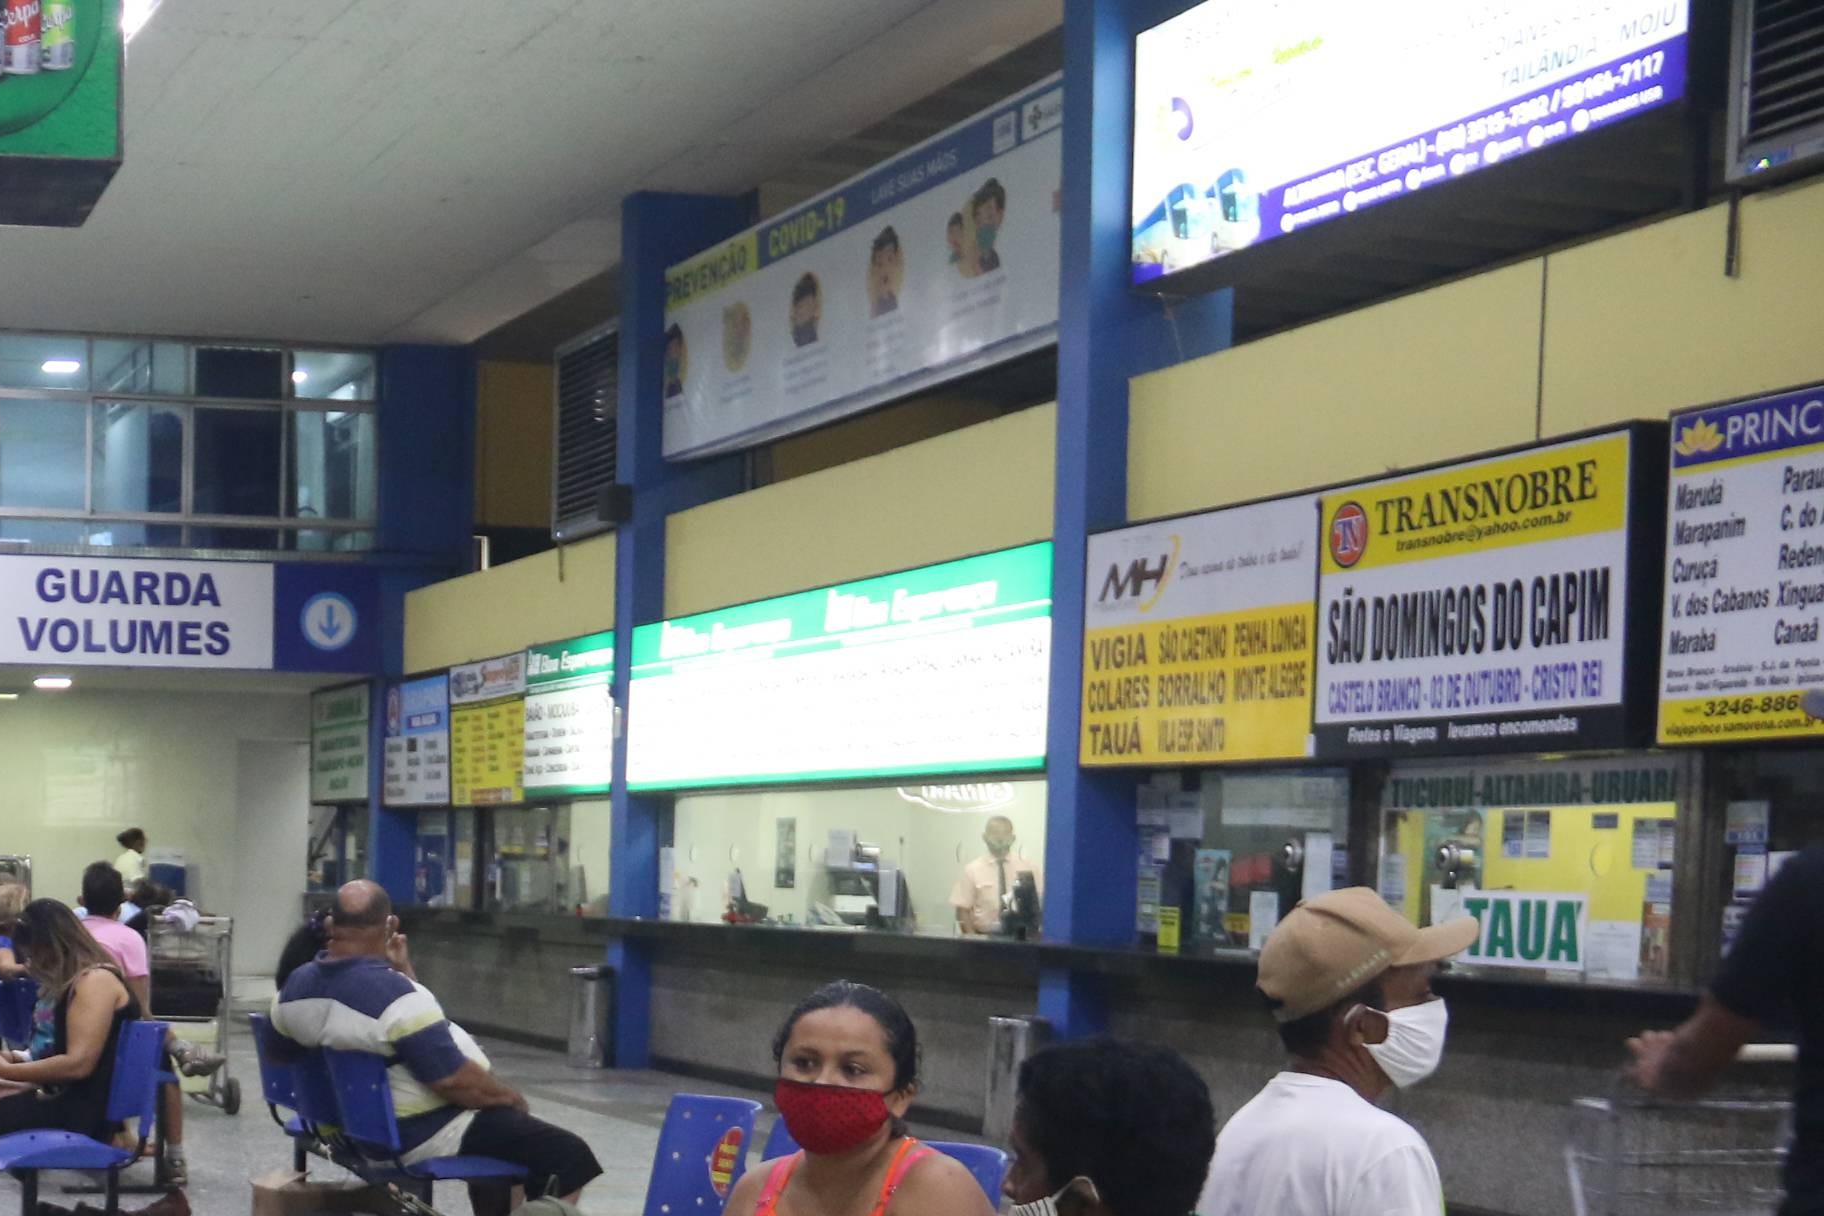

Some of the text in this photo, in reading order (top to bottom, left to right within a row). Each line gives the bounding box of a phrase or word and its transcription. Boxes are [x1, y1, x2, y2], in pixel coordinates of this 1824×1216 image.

[768, 197, 846, 257] COVID-19
[1377, 459, 1598, 536] TRANSNOBRE
[1799, 501, 1817, 528] do
[1395, 511, 1572, 552] transnobre@yahoo.com.br
[1674, 511, 1746, 547] Marapanim
[35, 568, 222, 607] GUARDA
[1098, 553, 1169, 602] MH
[1328, 566, 1610, 665] SÃO DOMINGOS DO CAPIM
[1685, 591, 1709, 617] dos
[1712, 586, 1771, 614] Cabanos
[18, 616, 231, 656] VOLUMES
[1090, 613, 1307, 672] VIGIA SÃO CAETANO PENHA LONGA
[1088, 660, 1307, 713] COLARES BORRALHO MONTE ALEGRE
[1328, 679, 1374, 714] CASTELO
[1376, 676, 1422, 712] BRANCO
[1430, 675, 1444, 709] 03
[1446, 673, 1461, 708] DE
[1464, 666, 1521, 707] OUTUBRO
[1531, 662, 1578, 701] CRISTO
[1581, 659, 1602, 697] REI
[1703, 694, 1802, 717] 3246-886
[1089, 716, 1142, 756] TAUÁ
[1196, 717, 1225, 752] SANTO
[1447, 720, 1496, 739] levamos
[1499, 714, 1578, 736] encomendas
